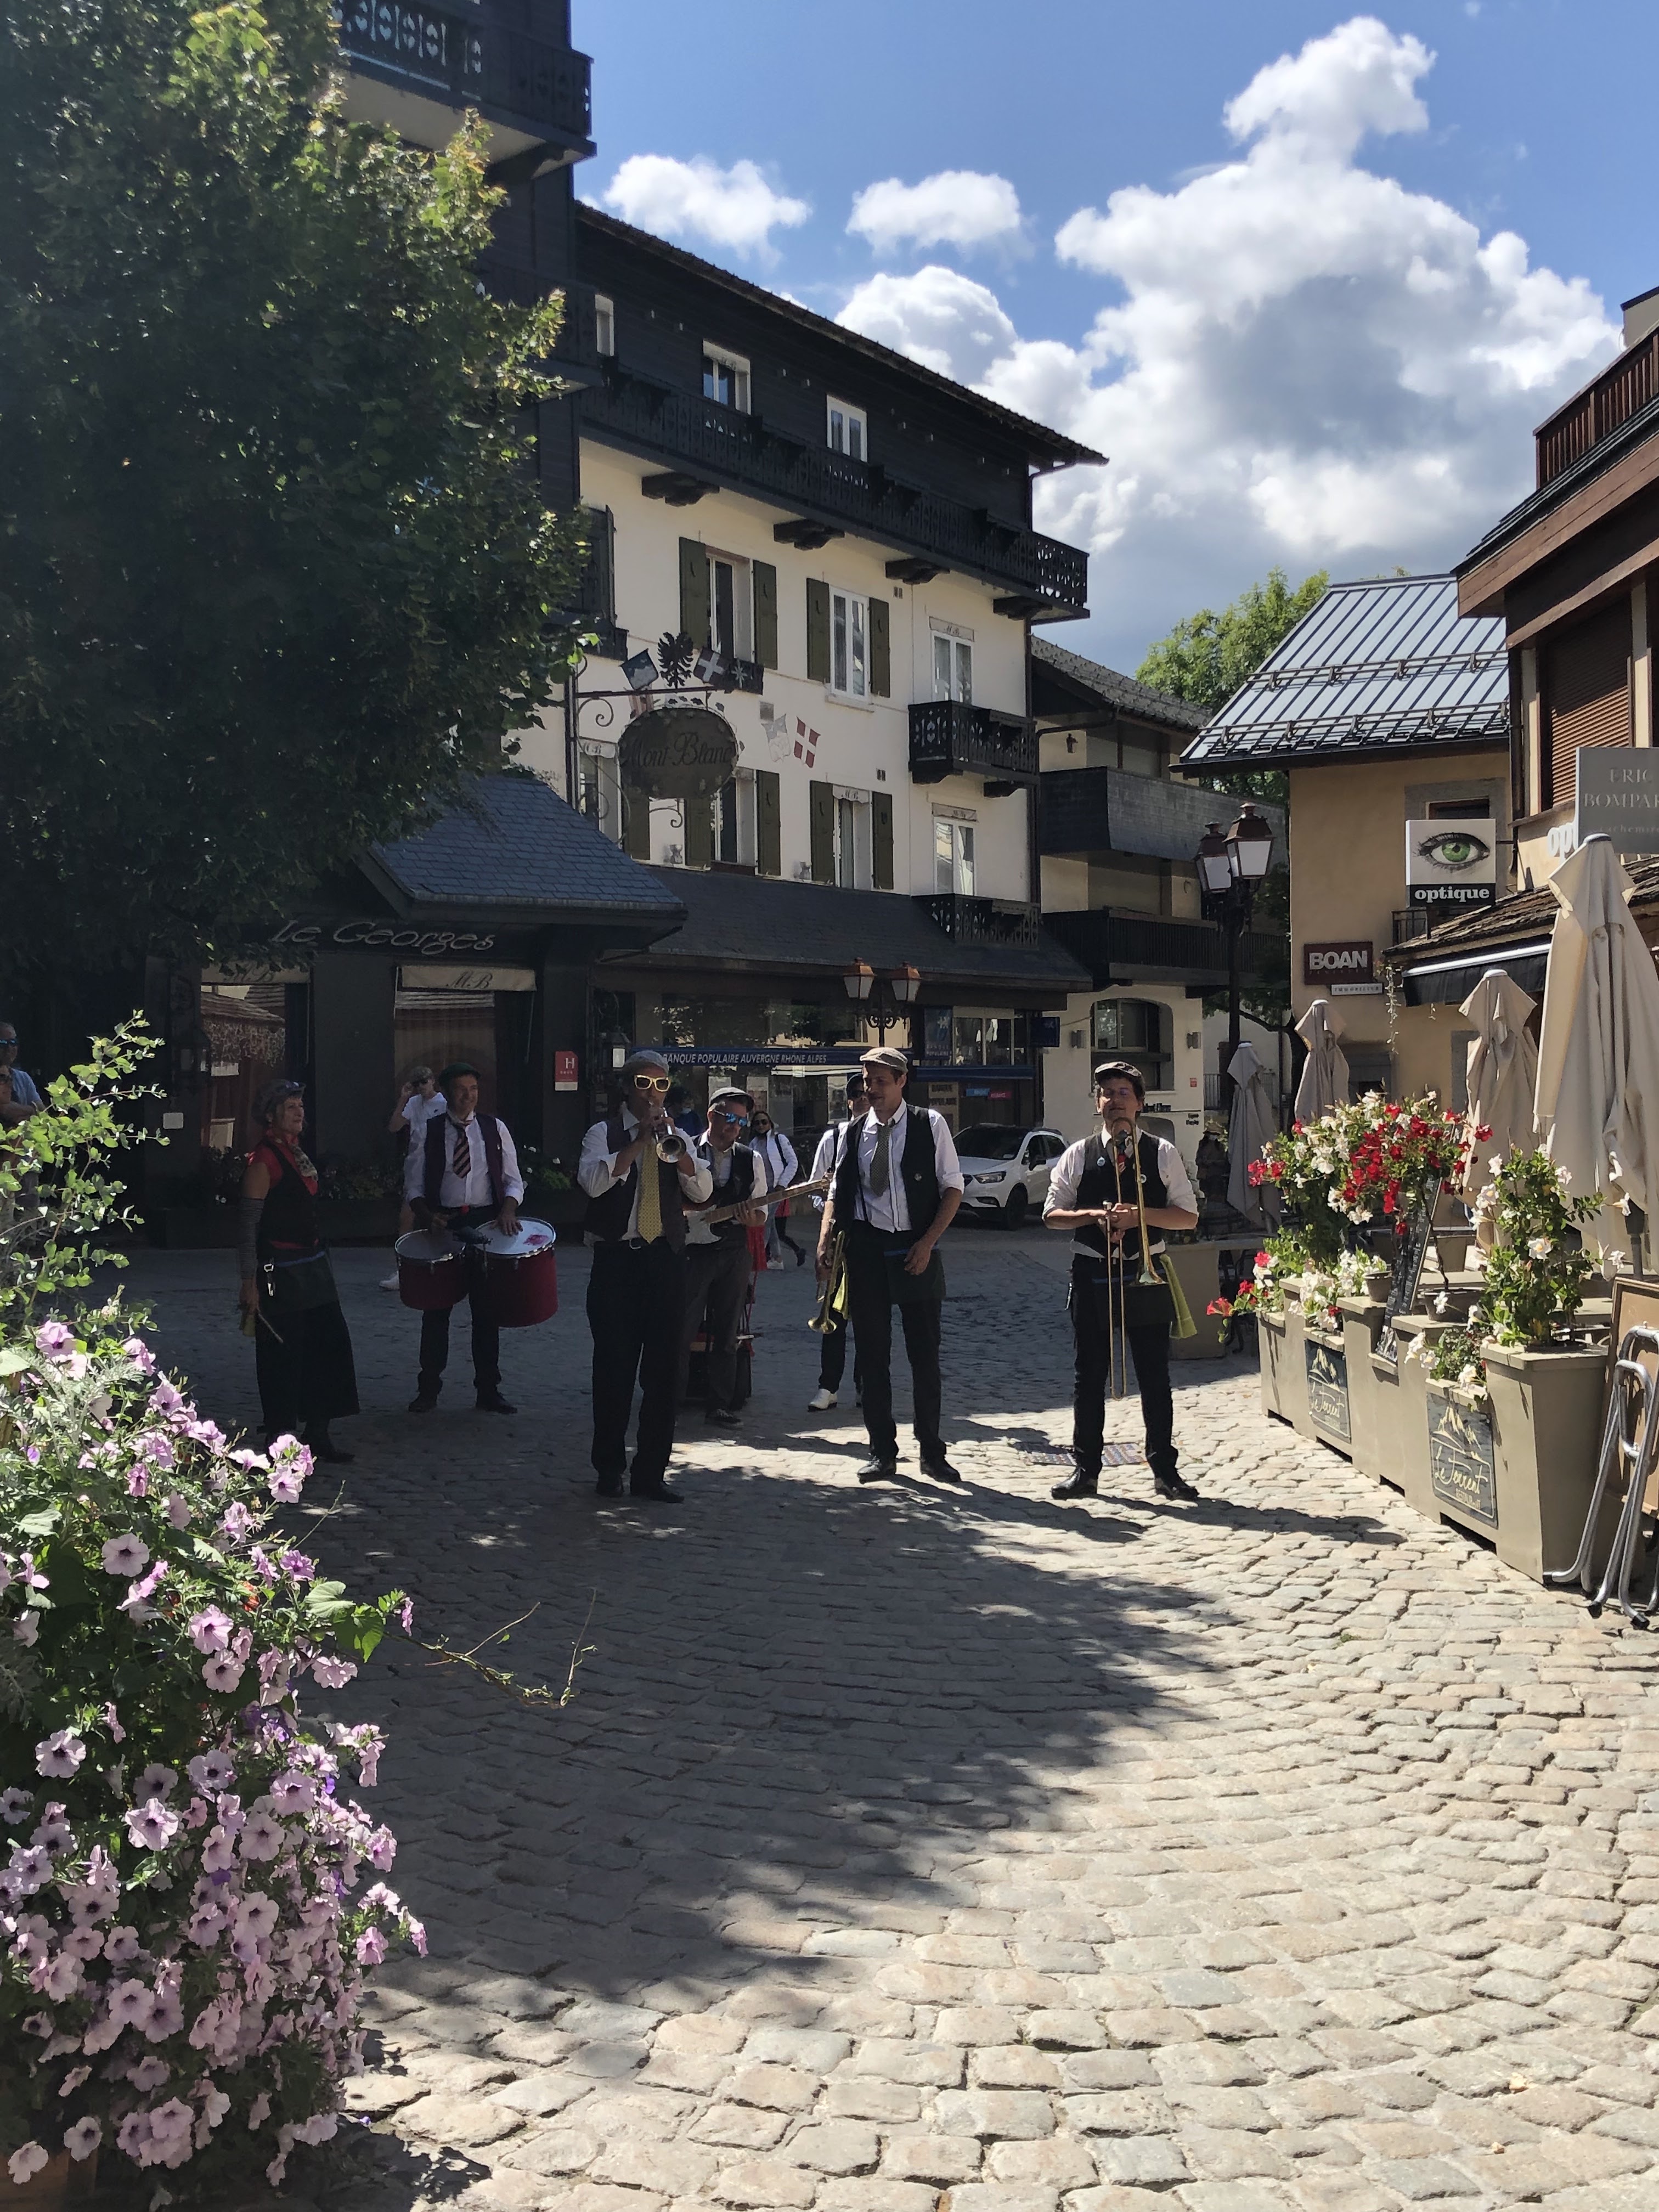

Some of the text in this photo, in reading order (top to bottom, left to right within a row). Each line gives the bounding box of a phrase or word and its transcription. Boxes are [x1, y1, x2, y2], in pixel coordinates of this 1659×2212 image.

[1610, 768, 1652, 783] ERIC
[1414, 885, 1491, 903] optique
[268, 919, 496, 955] Le Georges
[1308, 950, 1368, 970] BOAN
[565, 1057, 575, 1069] H
[697, 1053, 740, 1063] POPULAIRE
[740, 1053, 780, 1063] AUVERGNE
[781, 1054, 806, 1063] RHONE
[806, 1054, 828, 1063] ALPES
[1435, 1445, 1489, 1494] Le Torrent
